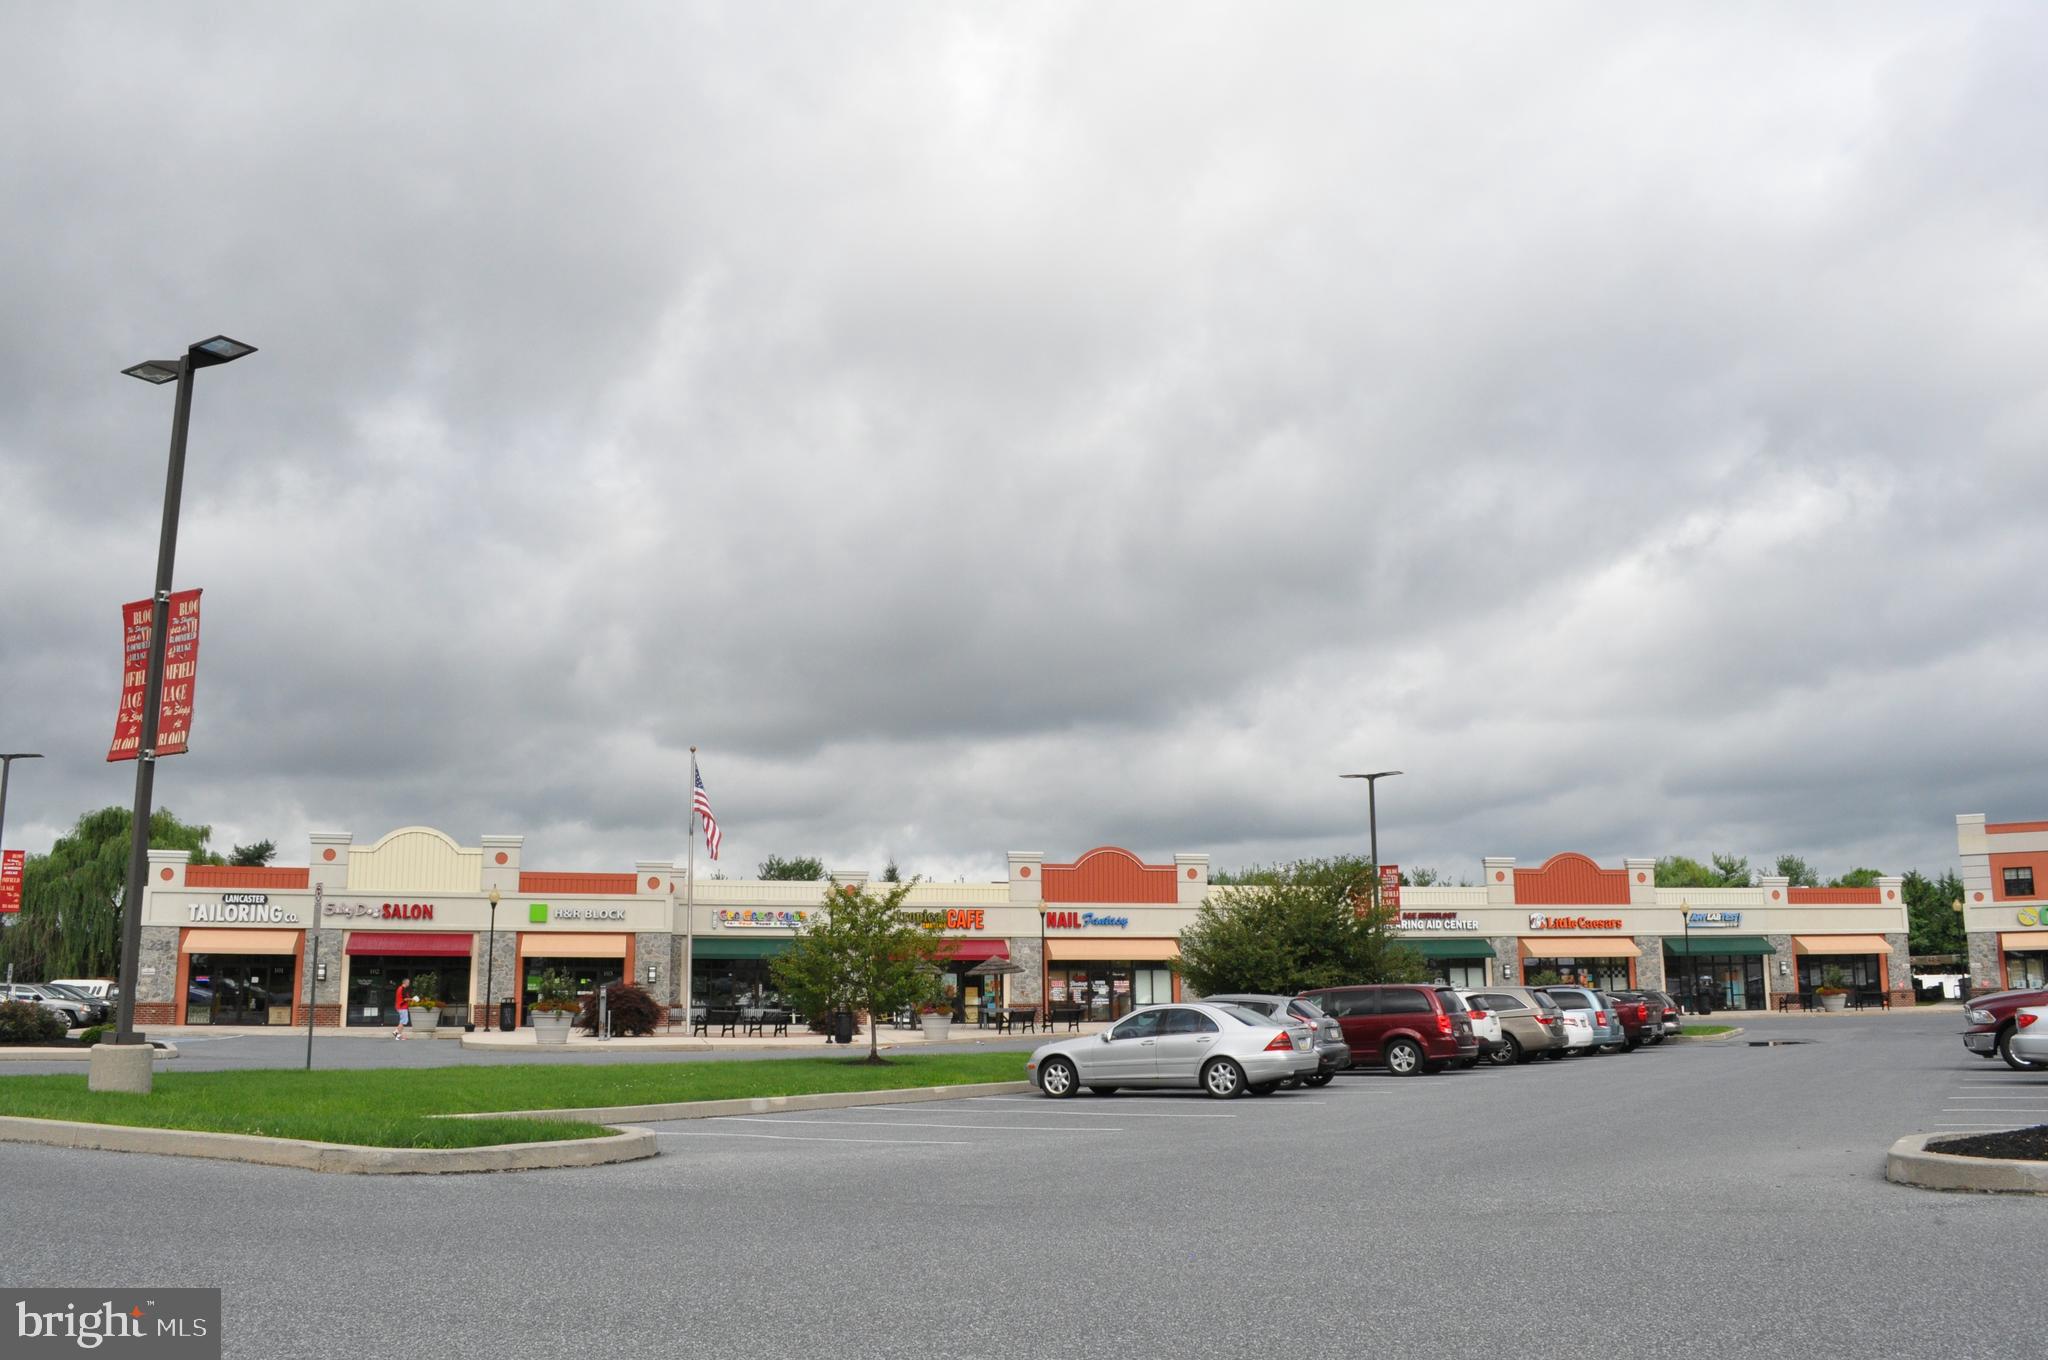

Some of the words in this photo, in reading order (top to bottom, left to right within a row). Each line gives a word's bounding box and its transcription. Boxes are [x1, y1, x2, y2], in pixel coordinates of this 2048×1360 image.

[224, 894, 265, 904] LANCASTER
[189, 903, 283, 923] TAILORING
[284, 912, 299, 923] CO.
[381, 903, 433, 920] SALON
[555, 909, 581, 920] H&R
[585, 909, 625, 920] BLOCK
[1707, 913, 1722, 922] LAB
[946, 909, 985, 929] CAFE
[1046, 912, 1082, 929] NAIL
[1082, 912, 1129, 930] Fantasy
[1383, 920, 1424, 930] RING
[1426, 920, 1442, 930] AID
[1444, 920, 1480, 930] CENTER
[1545, 916, 1577, 929] Little
[1577, 916, 1624, 929] Caesars
